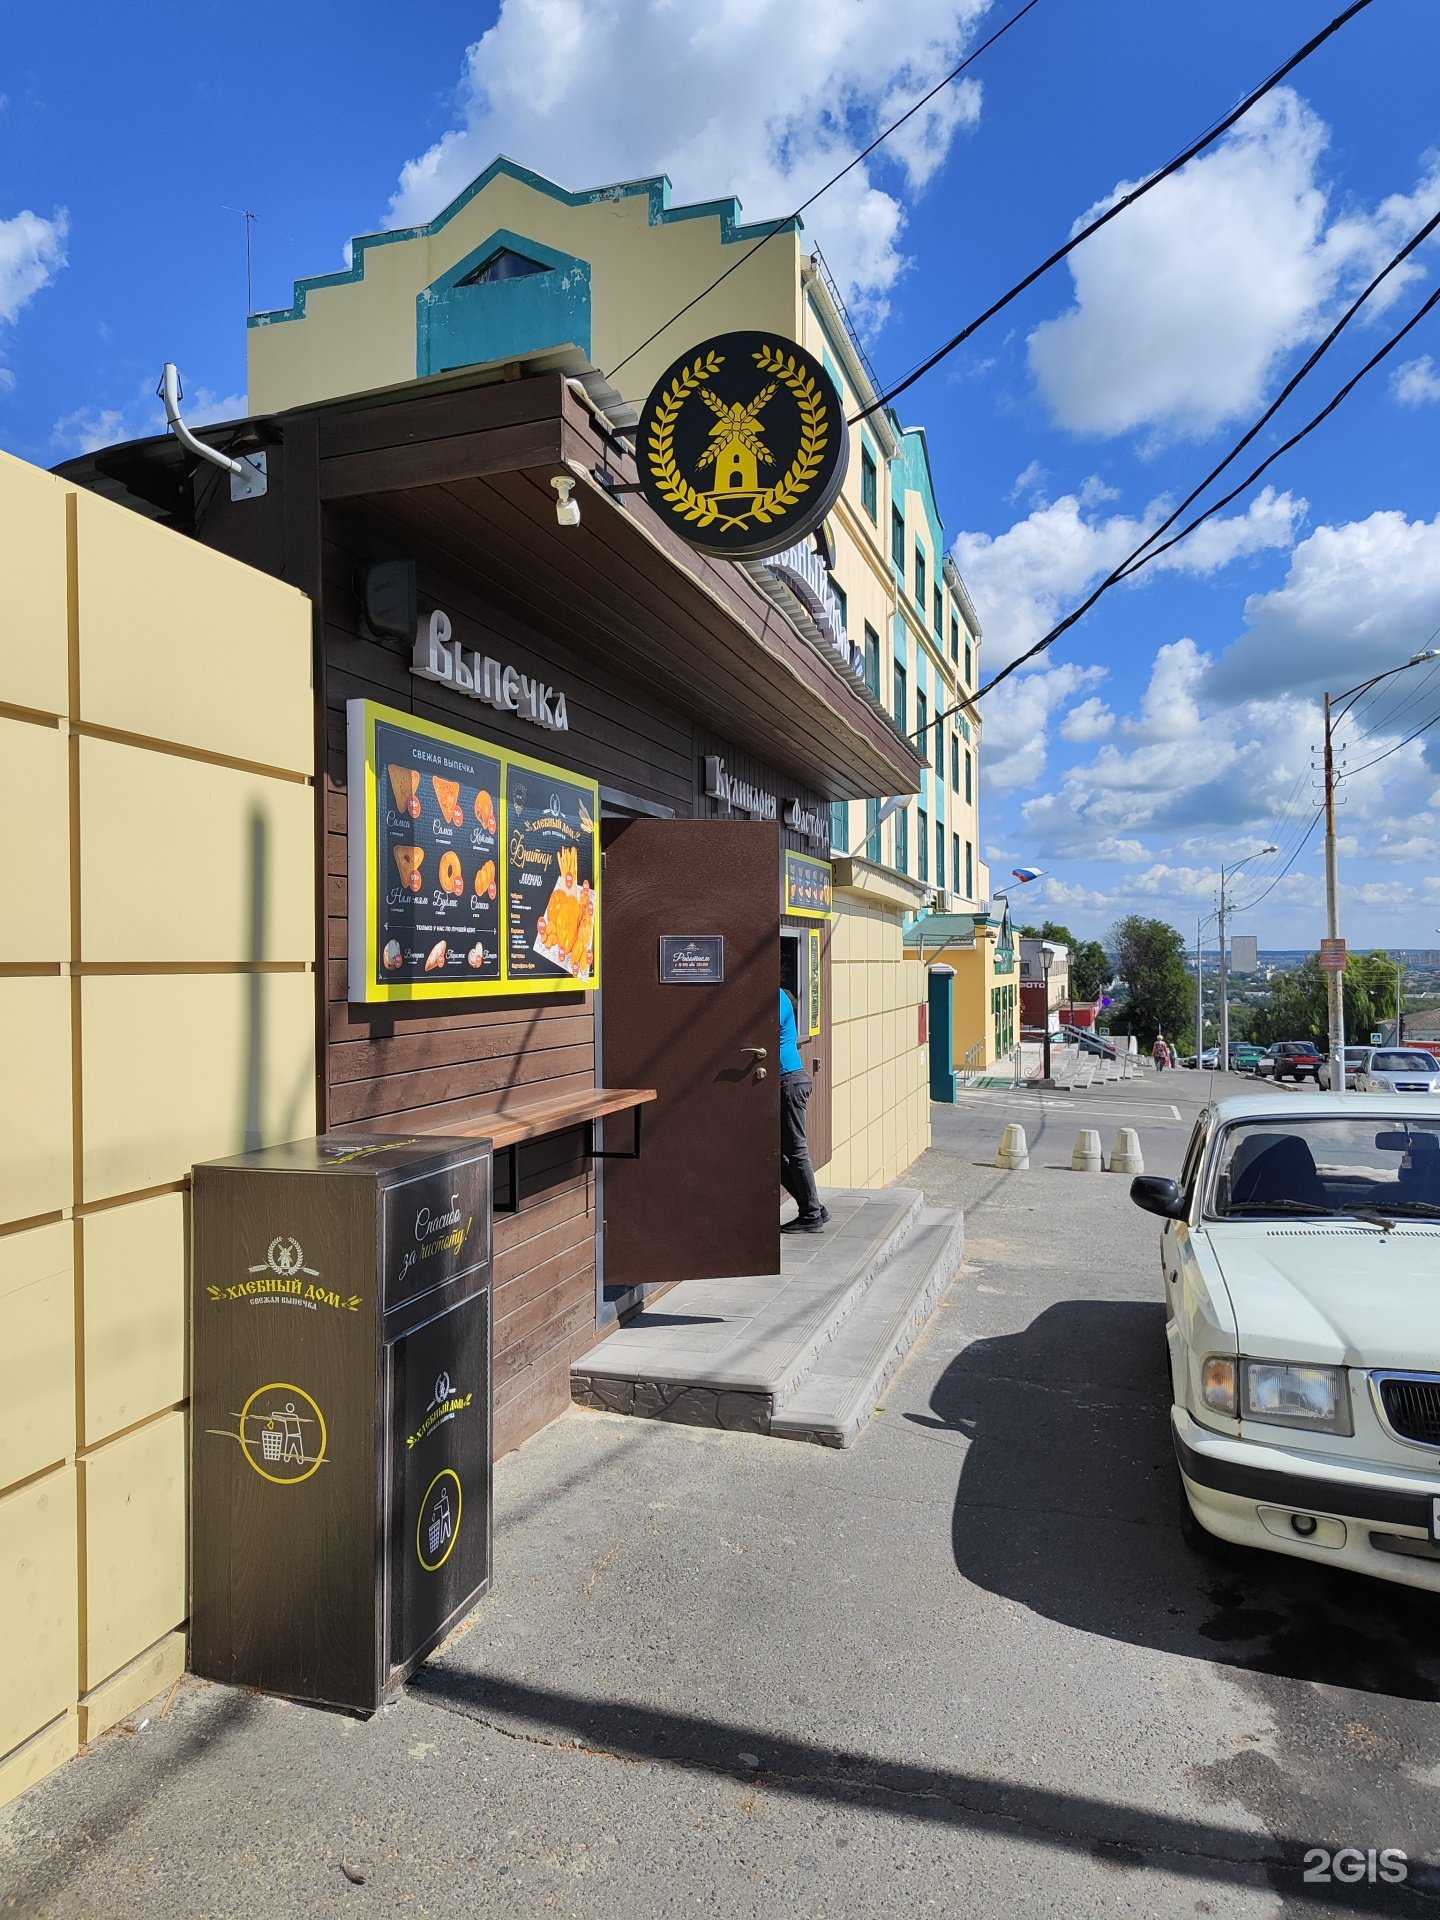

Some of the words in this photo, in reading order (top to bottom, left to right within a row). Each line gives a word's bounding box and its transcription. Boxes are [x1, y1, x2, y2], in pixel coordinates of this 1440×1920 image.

[412, 748, 441, 767] СВЕЖАЯ
[443, 757, 475, 775] ВЫПЕЧКА
[415, 1193, 461, 1241] Спасибо
[399, 1249, 417, 1281] за
[226, 1278, 303, 1300] ХЛЕБНЫЙ
[304, 1284, 341, 1308] ДОМ
[250, 1296, 280, 1306] СВЕЖАЯ
[281, 1296, 318, 1311] ВЫПЕЧКА
